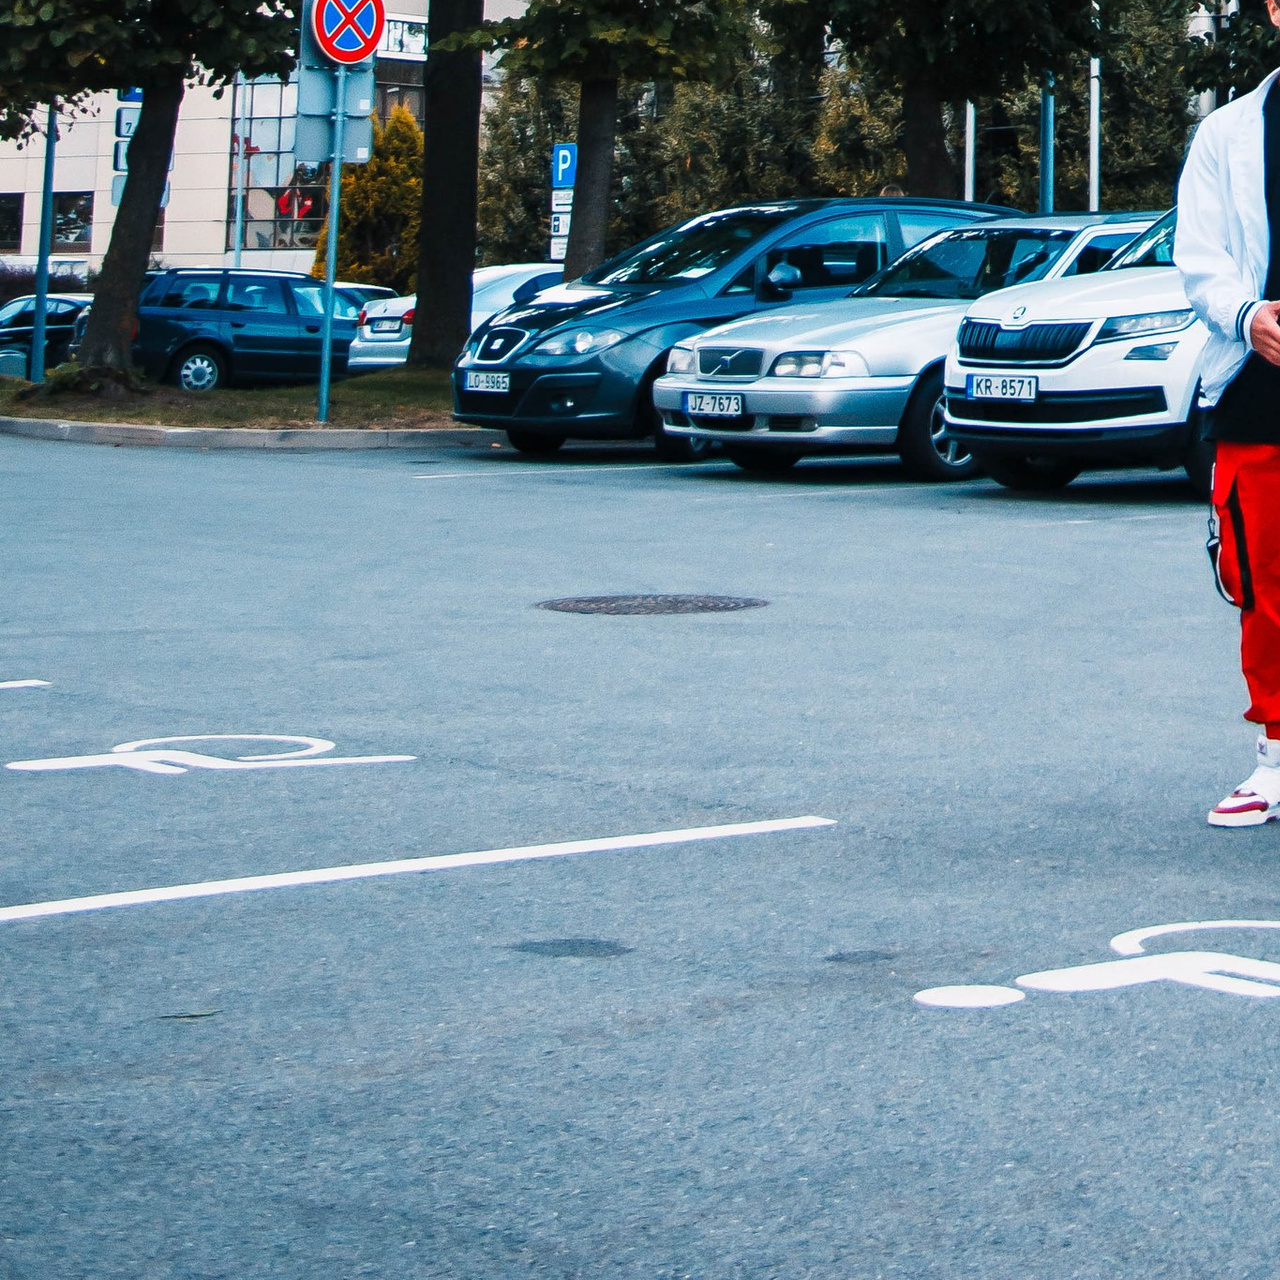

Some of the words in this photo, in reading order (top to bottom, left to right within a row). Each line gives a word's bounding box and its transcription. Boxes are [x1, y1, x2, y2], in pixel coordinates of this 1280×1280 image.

[558, 149, 571, 181] P
[975, 378, 1032, 397] KR-8571
[690, 395, 740, 413] JZ-7673
